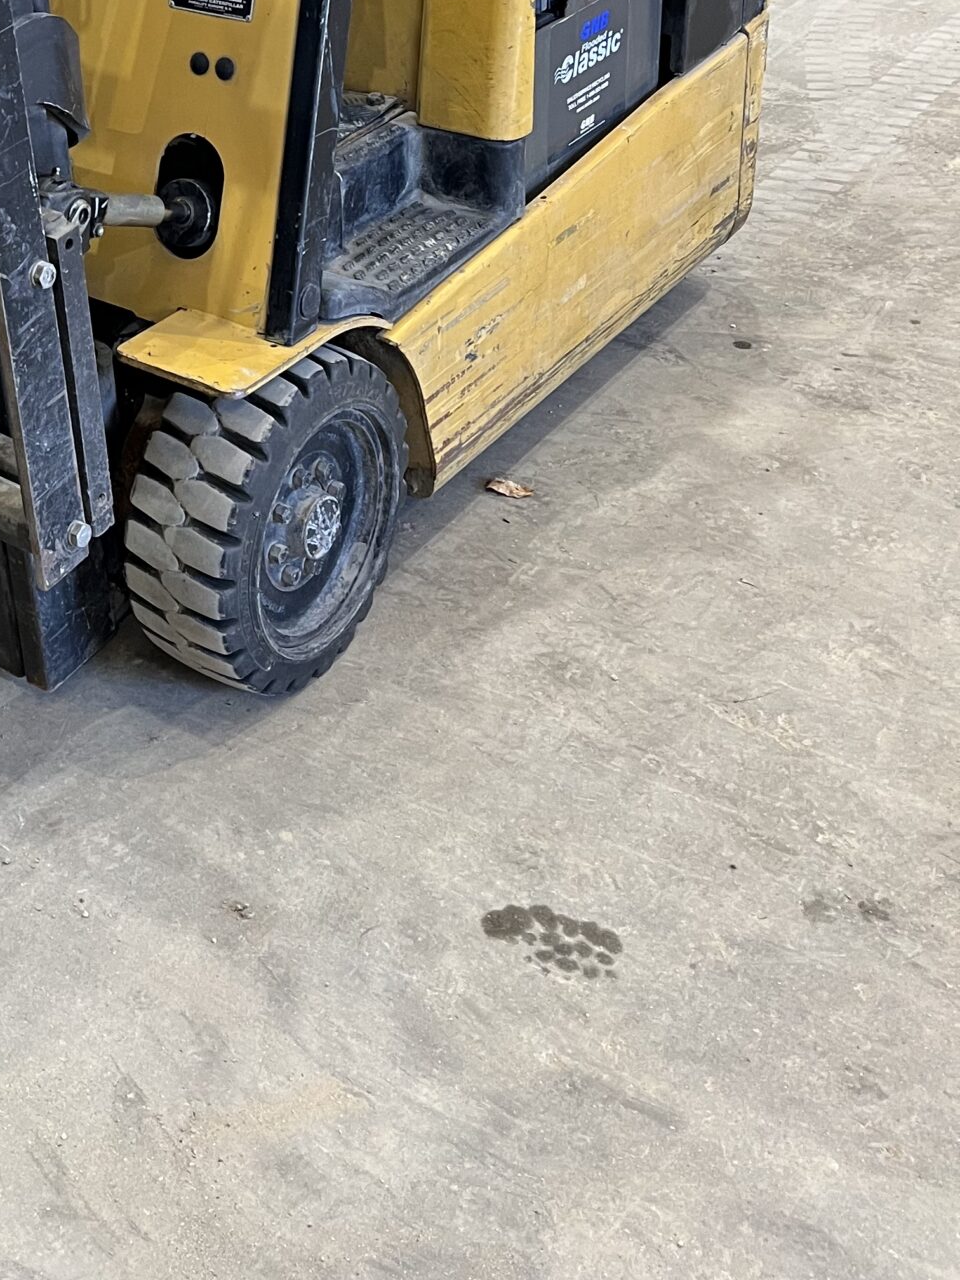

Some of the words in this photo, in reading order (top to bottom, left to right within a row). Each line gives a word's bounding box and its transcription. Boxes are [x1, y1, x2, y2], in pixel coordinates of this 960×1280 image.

[580, 10, 610, 41] GNB
[554, 30, 621, 84] Classic
[581, 30, 607, 53] Flooded
